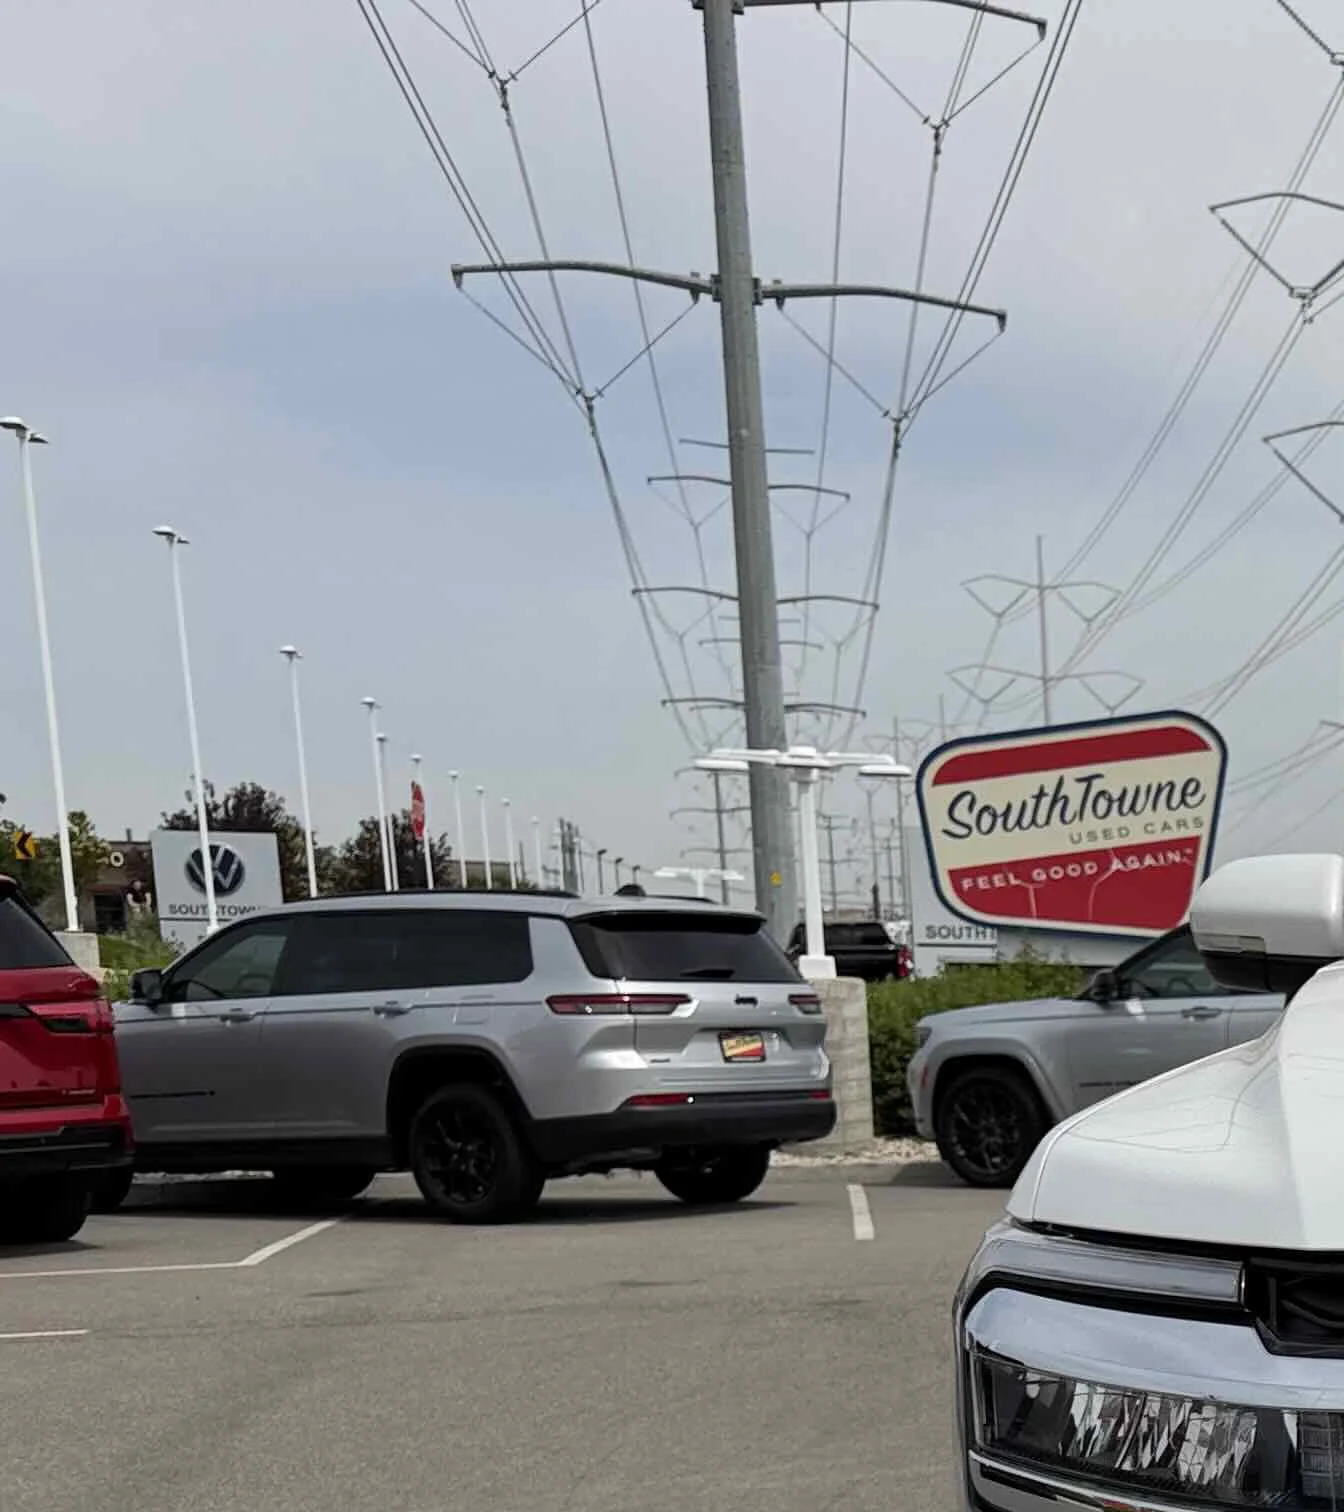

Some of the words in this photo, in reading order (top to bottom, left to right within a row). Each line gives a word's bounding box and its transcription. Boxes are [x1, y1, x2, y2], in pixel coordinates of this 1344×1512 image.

[941, 773, 1206, 839] SouthTowne
[1069, 826, 1131, 845] USED
[1143, 816, 1204, 835] CARS
[960, 874, 1018, 891] FEEL
[1032, 860, 1098, 882] GOOD
